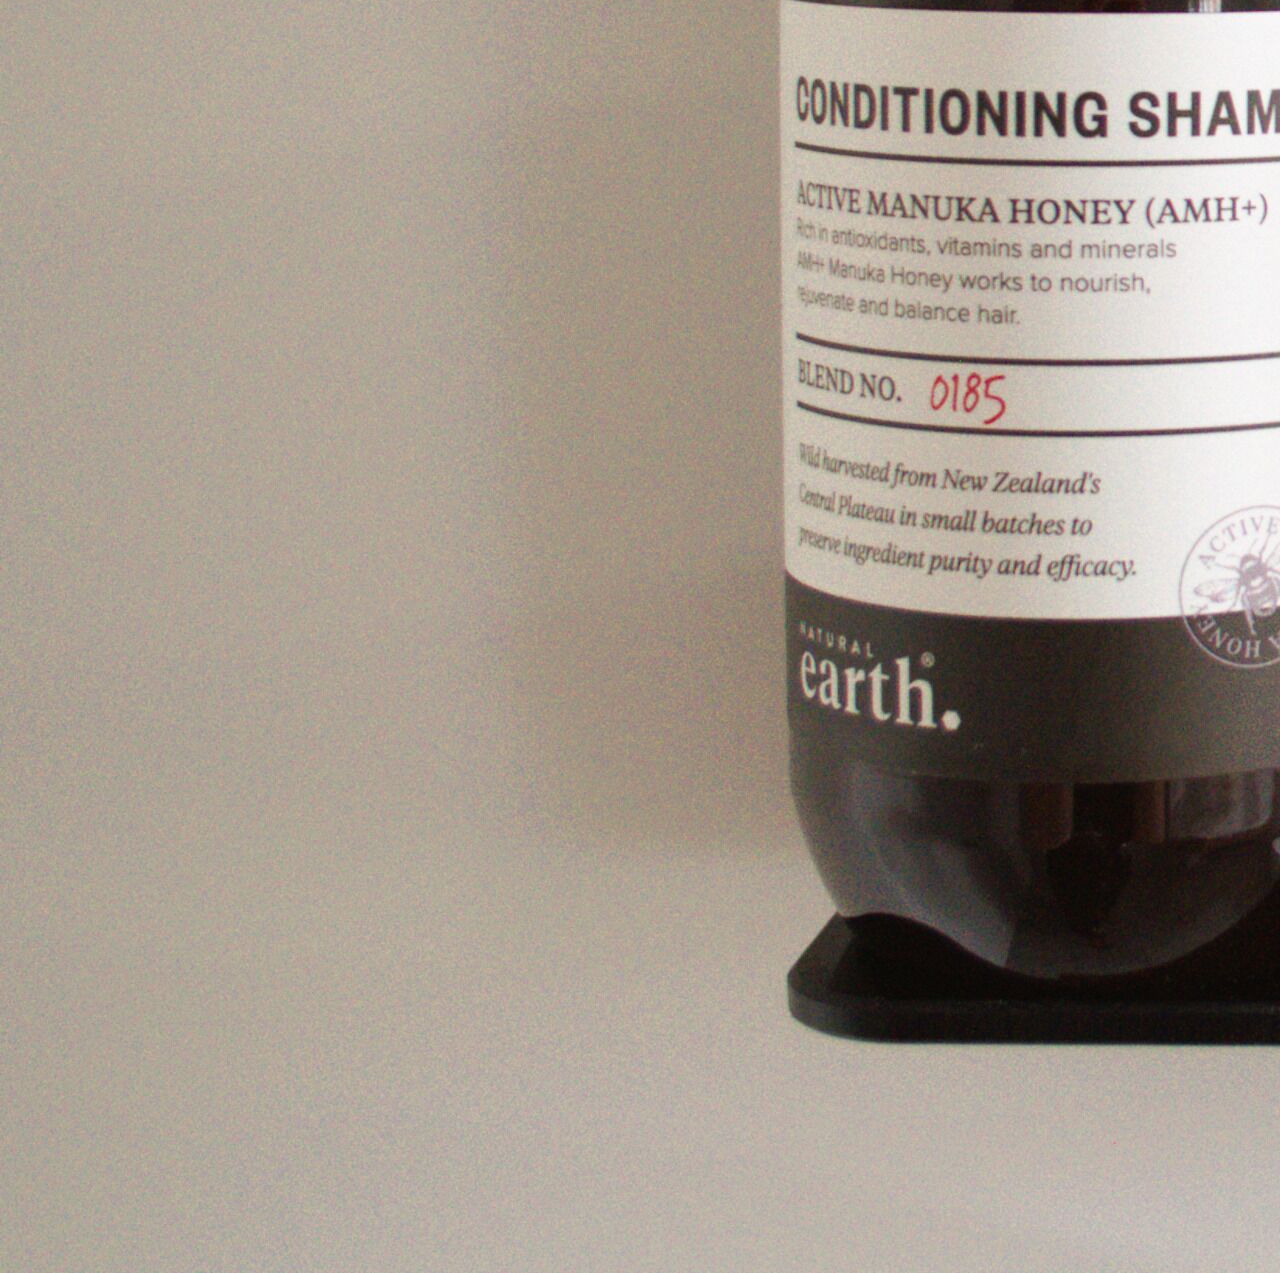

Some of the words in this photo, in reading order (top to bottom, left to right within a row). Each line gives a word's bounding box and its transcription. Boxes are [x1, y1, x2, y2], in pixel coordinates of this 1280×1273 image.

[796, 76, 1108, 138] CONDITIONING
[797, 180, 861, 214] ACTIVE
[867, 192, 1000, 223] MANUKA
[1009, 199, 1135, 225] HONEY
[1146, 193, 1269, 227] (AMH+)
[797, 217, 816, 239] Rich
[819, 224, 828, 239] in
[832, 228, 931, 255] antioxidants,
[936, 237, 1022, 258] vitamins
[1032, 238, 1073, 259] and
[1080, 238, 1177, 259] minerals
[829, 257, 885, 283] Manuka
[891, 266, 953, 293] Honey
[960, 272, 1022, 291] works
[1032, 272, 1053, 292] to
[1060, 272, 1151, 296] nourish,
[859, 297, 888, 316] and
[895, 299, 970, 322] balance
[977, 304, 1020, 324] hair.
[797, 358, 854, 396] BLEND
[861, 372, 902, 402] NO.
[930, 373, 1006, 424] 0185
[823, 450, 891, 482] harvested
[891, 463, 937, 488] from
[942, 469, 988, 491] New
[993, 472, 1100, 495] Zealand's
[800, 483, 835, 512] Central
[838, 495, 895, 524] Plateau
[900, 506, 916, 526] in
[922, 510, 977, 532] small
[981, 514, 1064, 535] batches
[1071, 517, 1092, 536] to
[799, 528, 841, 554] preserve
[844, 535, 924, 565] ingredient
[928, 552, 992, 578] purity
[997, 555, 1040, 576] and
[1047, 554, 1136, 581] efficacy.
[1199, 516, 1280, 569] ACTIVE
[800, 622, 874, 657] NATURAL
